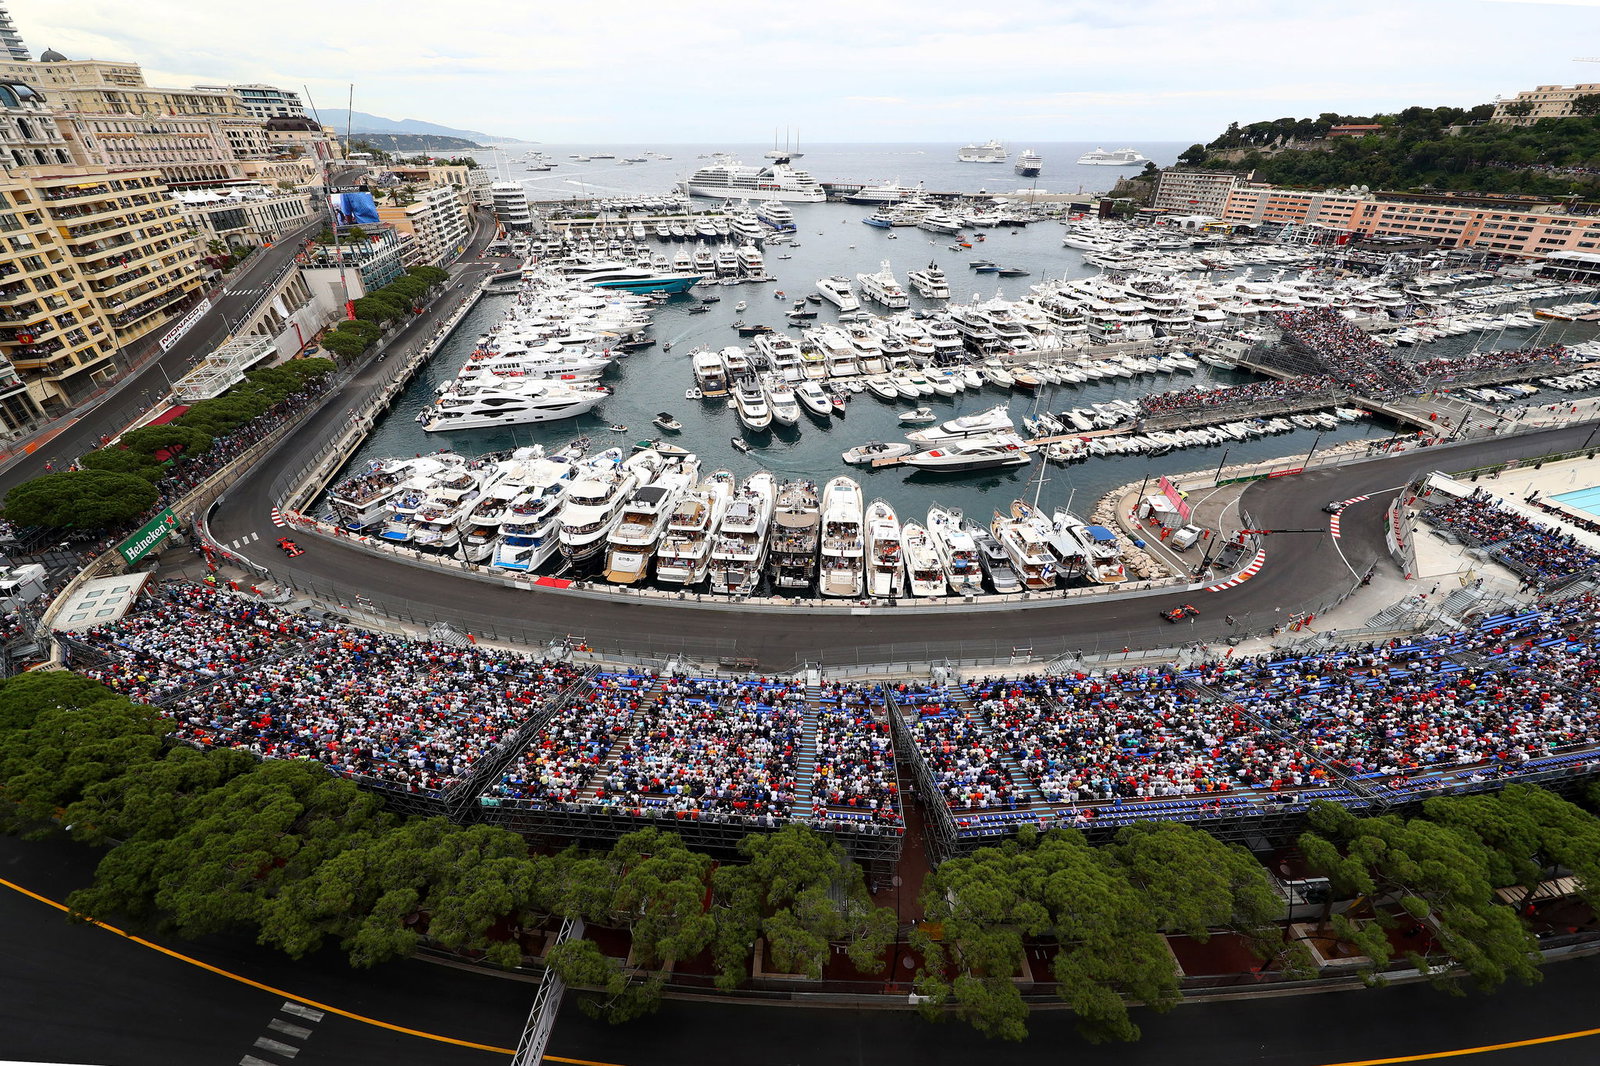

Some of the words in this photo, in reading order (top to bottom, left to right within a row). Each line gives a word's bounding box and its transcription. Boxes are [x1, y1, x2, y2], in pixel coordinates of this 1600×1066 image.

[162, 308, 199, 344] MONACO
[166, 333, 181, 349] GP
[125, 524, 166, 560] Heineken
